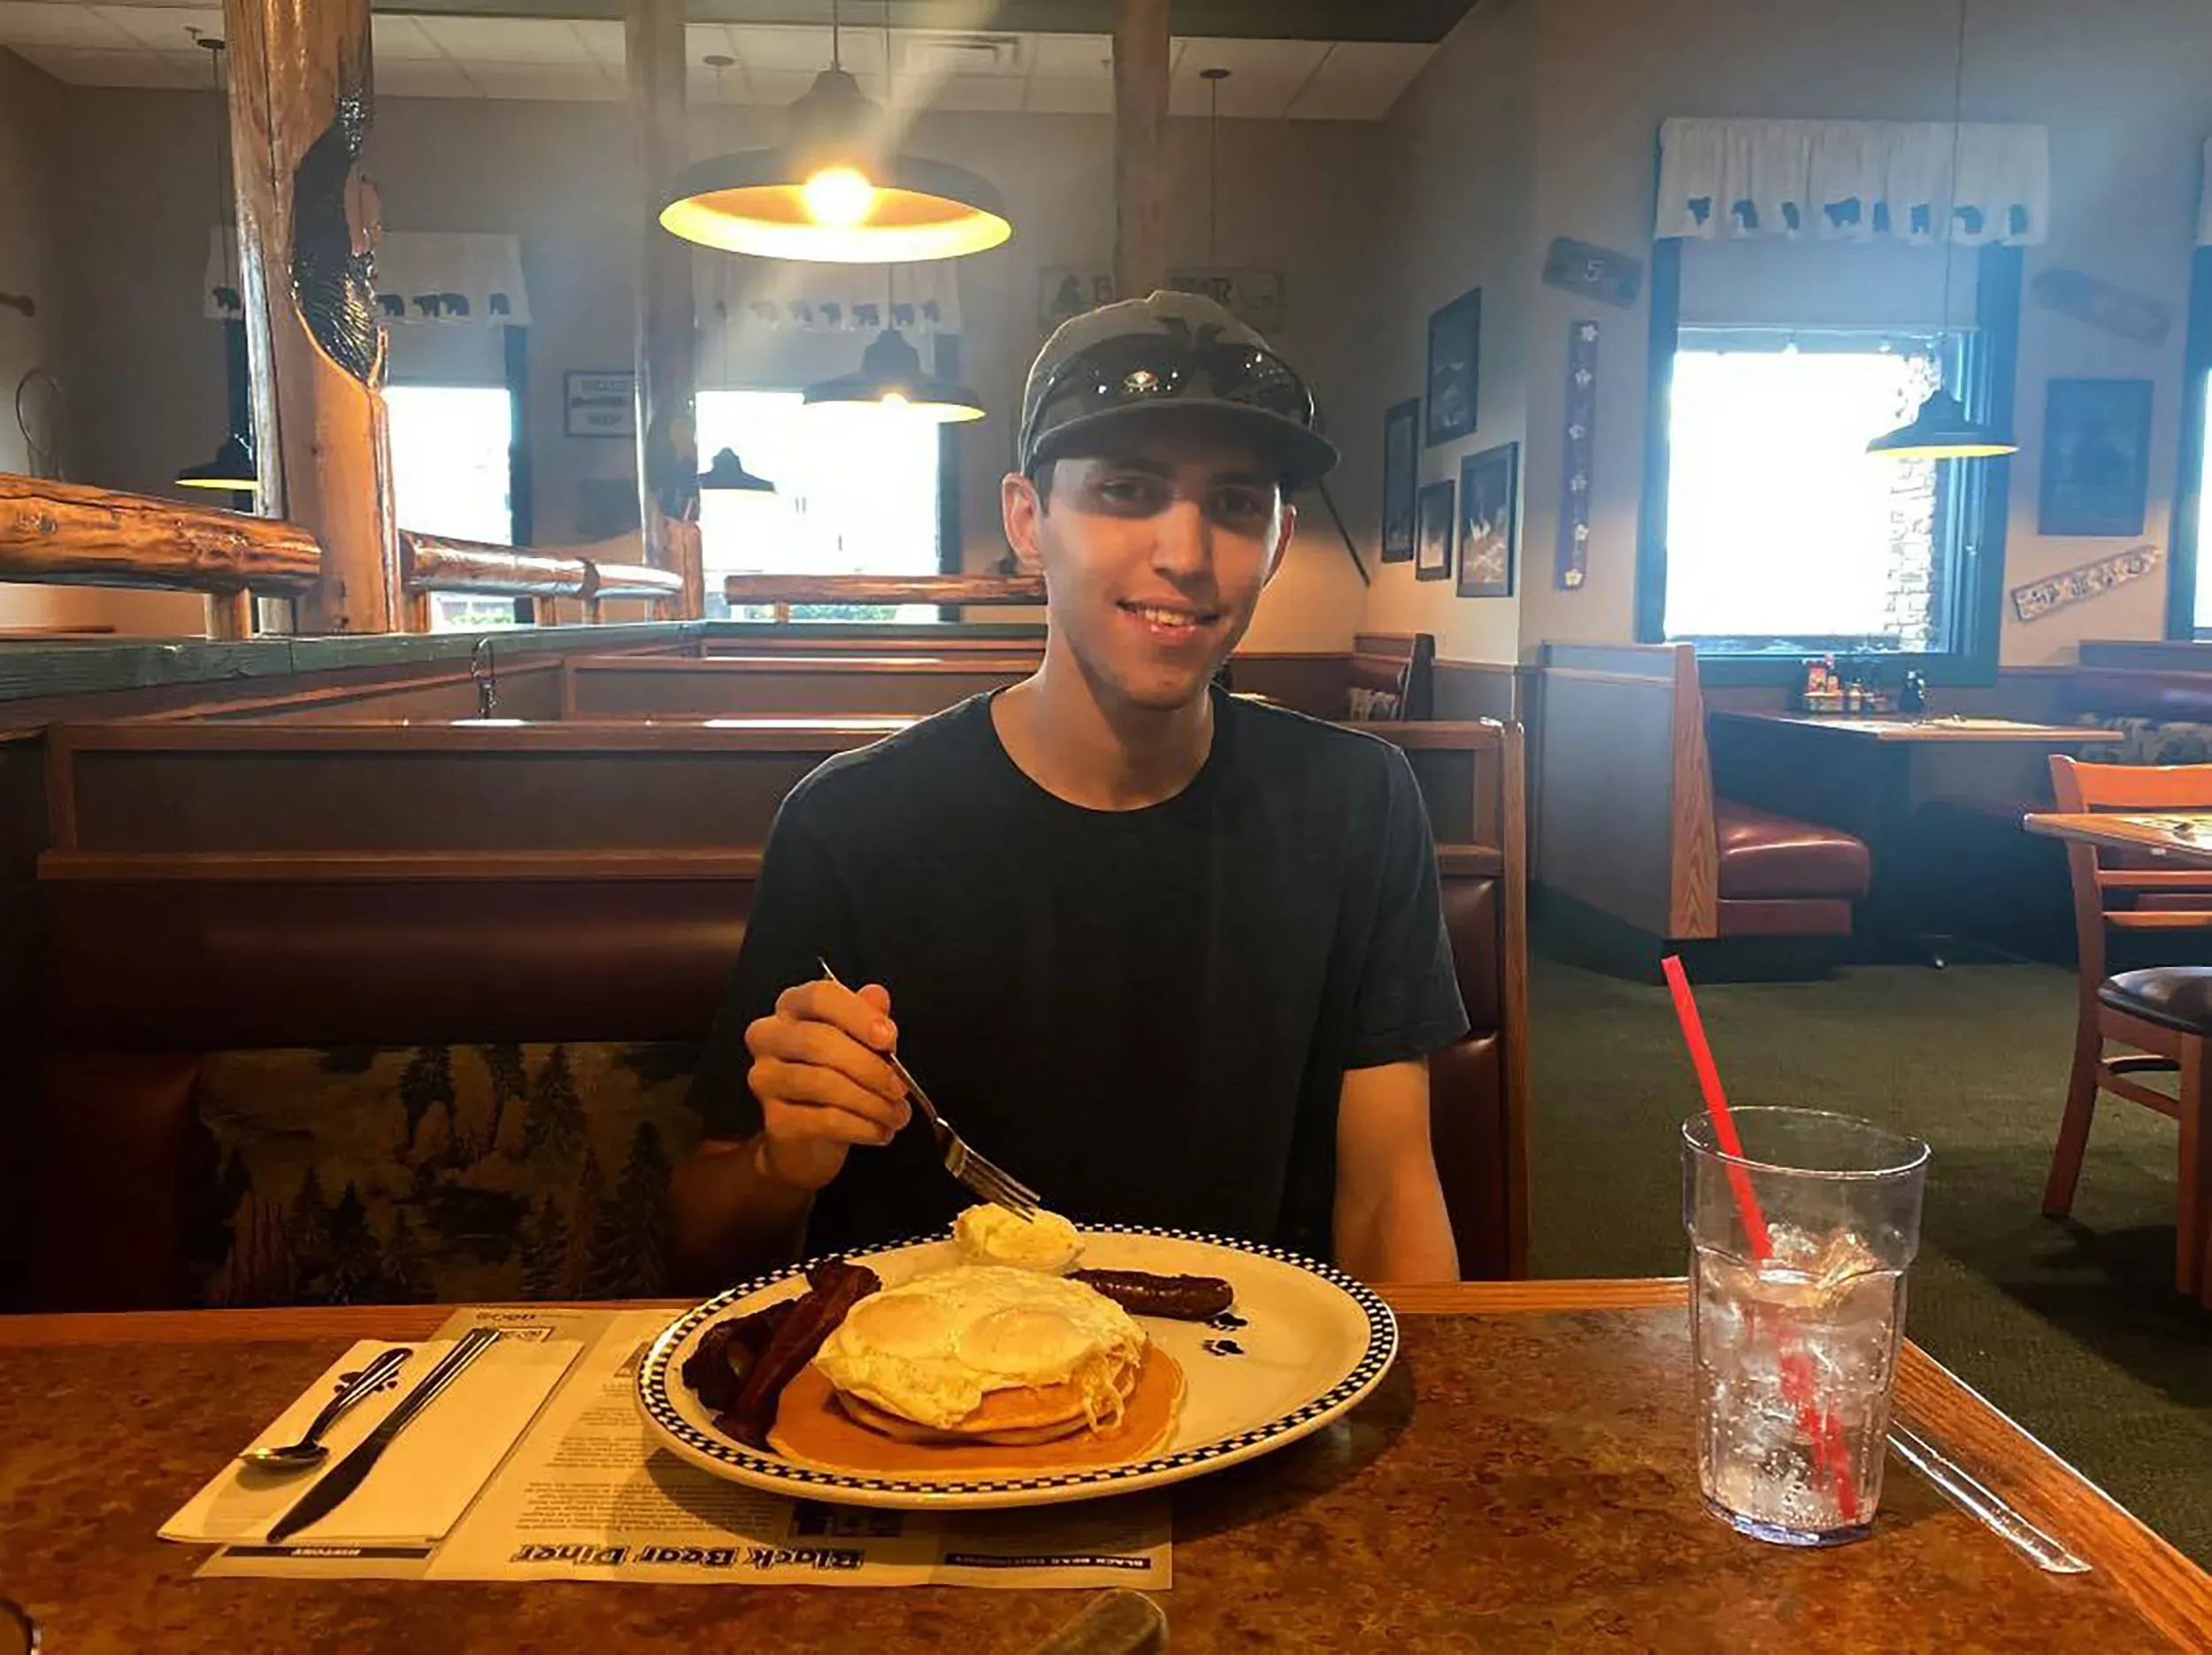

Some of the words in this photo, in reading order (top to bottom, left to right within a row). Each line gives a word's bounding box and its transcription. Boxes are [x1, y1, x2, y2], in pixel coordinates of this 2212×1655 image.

[1582, 259, 1605, 283] 5
[509, 1544, 634, 1566] Diner
[633, 1545, 740, 1568] Bear
[744, 1546, 864, 1570] Black
